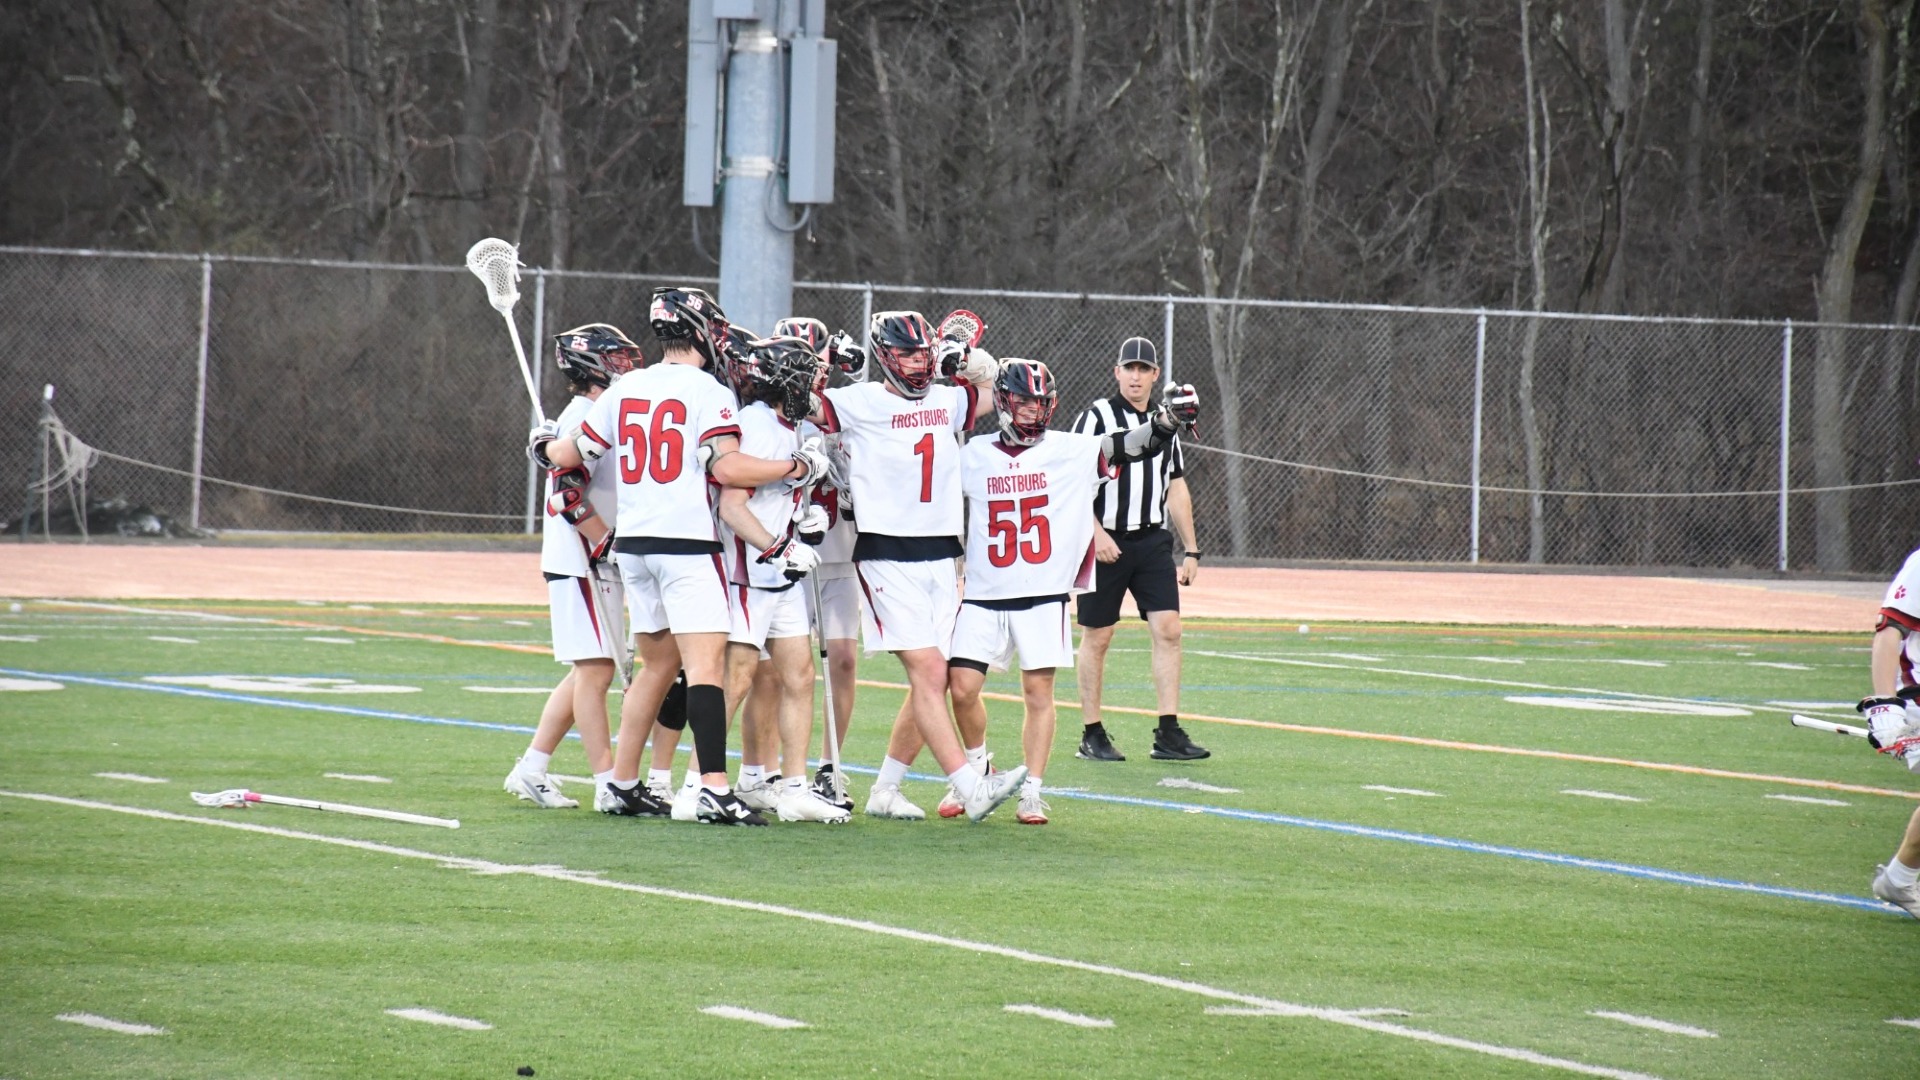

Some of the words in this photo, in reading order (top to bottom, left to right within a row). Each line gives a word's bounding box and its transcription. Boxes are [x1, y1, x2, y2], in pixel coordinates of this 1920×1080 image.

[686, 294, 703, 311] 56
[570, 336, 589, 351] 25
[891, 408, 949, 429] FROSTBURG
[618, 398, 687, 484] 56
[913, 433, 935, 503] 1
[987, 472, 1048, 495] FROSTBURG
[987, 495, 1052, 569] 55
[782, 542, 797, 560] STX
[1869, 705, 1890, 716] STX
